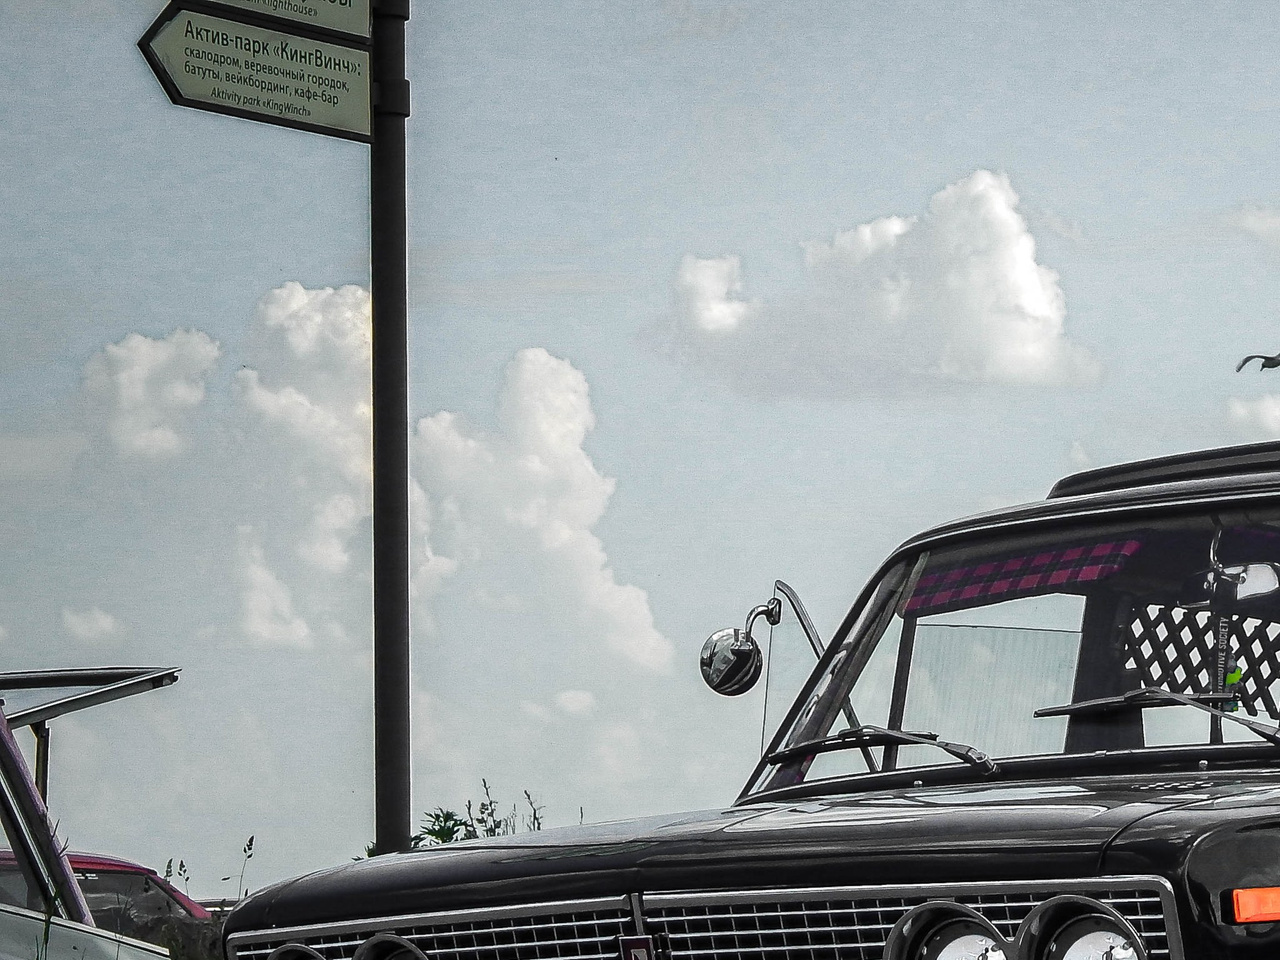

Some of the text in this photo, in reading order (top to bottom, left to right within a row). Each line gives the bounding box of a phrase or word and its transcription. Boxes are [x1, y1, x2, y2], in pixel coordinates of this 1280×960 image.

[184, 20, 361, 76] Актив-парк «КингВинч»:
[184, 46, 350, 93] скалодром, веревочный городок,
[184, 61, 339, 107] батуты, вейкбординг, кафе-бар
[211, 86, 312, 118] Aktivity park «KingWinch»
[1219, 617, 1230, 650] SOCIETY
